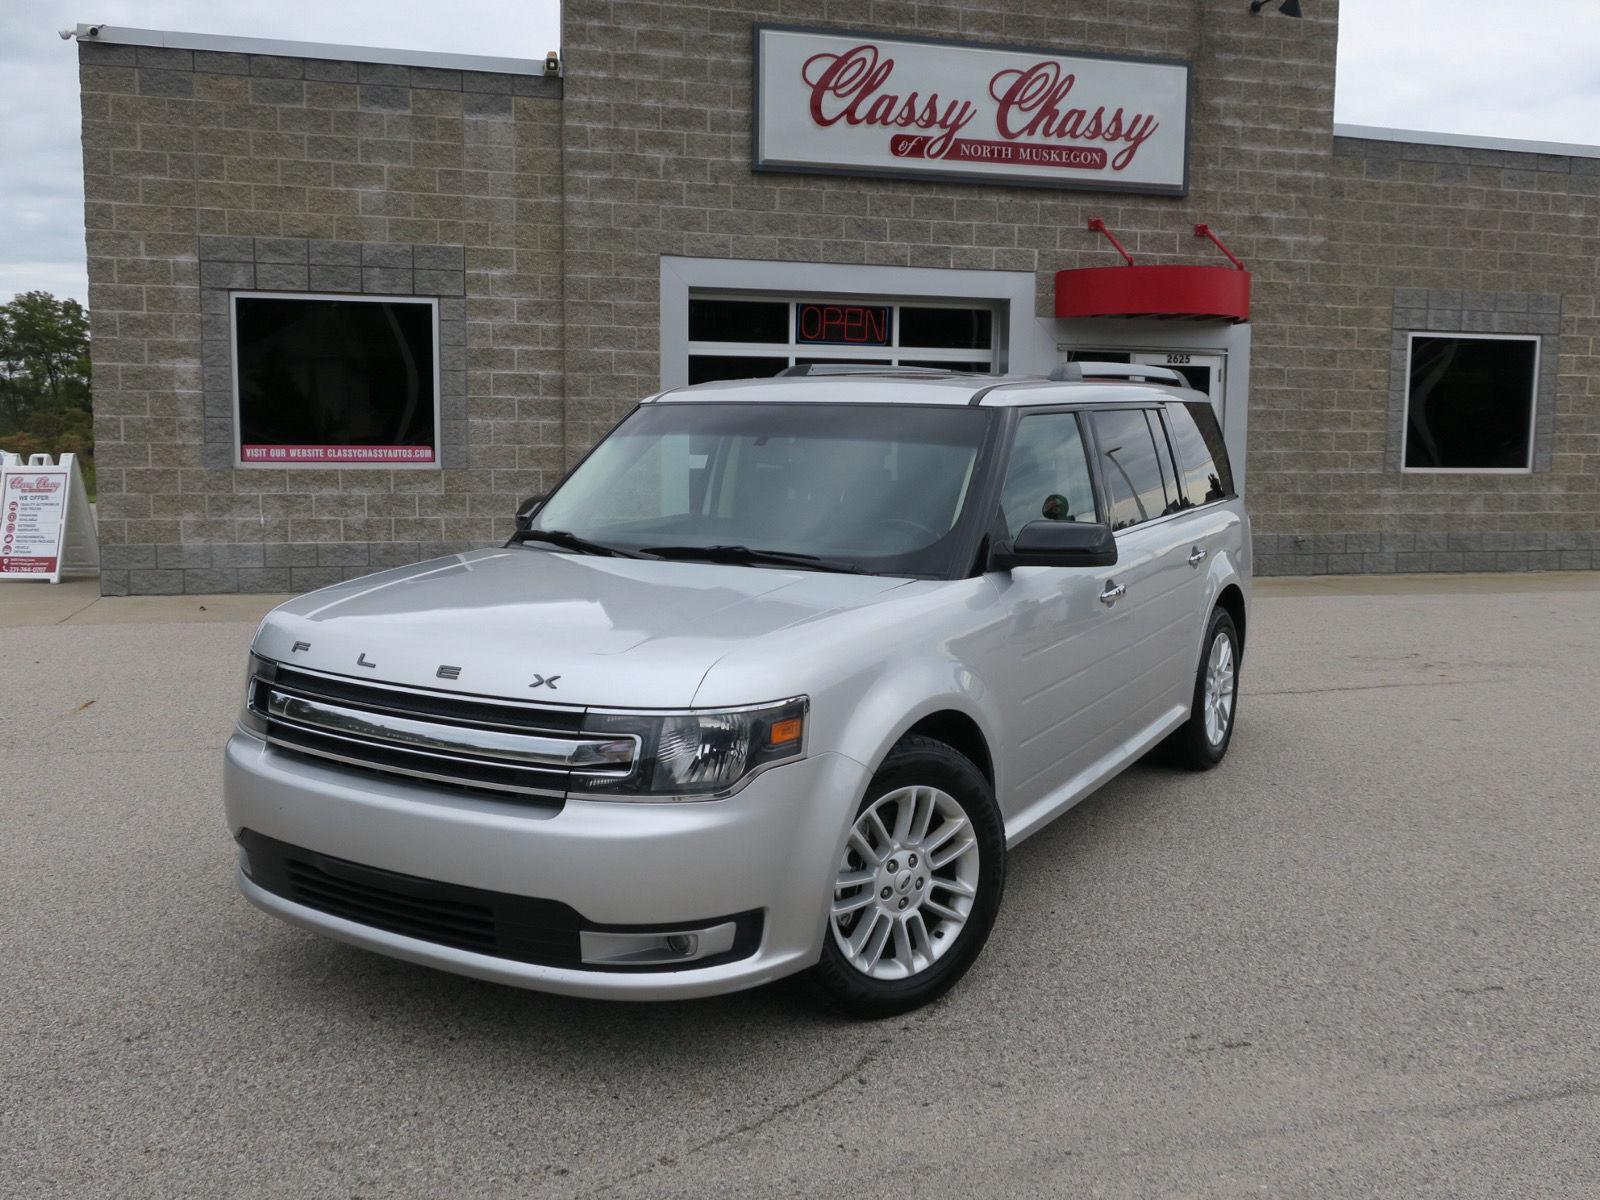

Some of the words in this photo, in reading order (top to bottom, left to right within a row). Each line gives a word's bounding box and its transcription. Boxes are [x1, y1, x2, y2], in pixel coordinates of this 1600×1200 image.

[802, 45, 977, 159] Classy
[989, 60, 1160, 171] Chassy
[897, 136, 923, 157] of
[960, 143, 1012, 159] NORTH
[1019, 148, 1101, 165] MUSKEGON
[801, 306, 886, 342] OPEN
[1166, 353, 1191, 364] 2625
[246, 448, 267, 458] VISIT
[269, 448, 286, 458] OUR
[289, 448, 325, 458] WEBSITE
[327, 448, 432, 458] CLASSYCHASSYAUTOS.COM
[291, 640, 561, 690] FLEX
